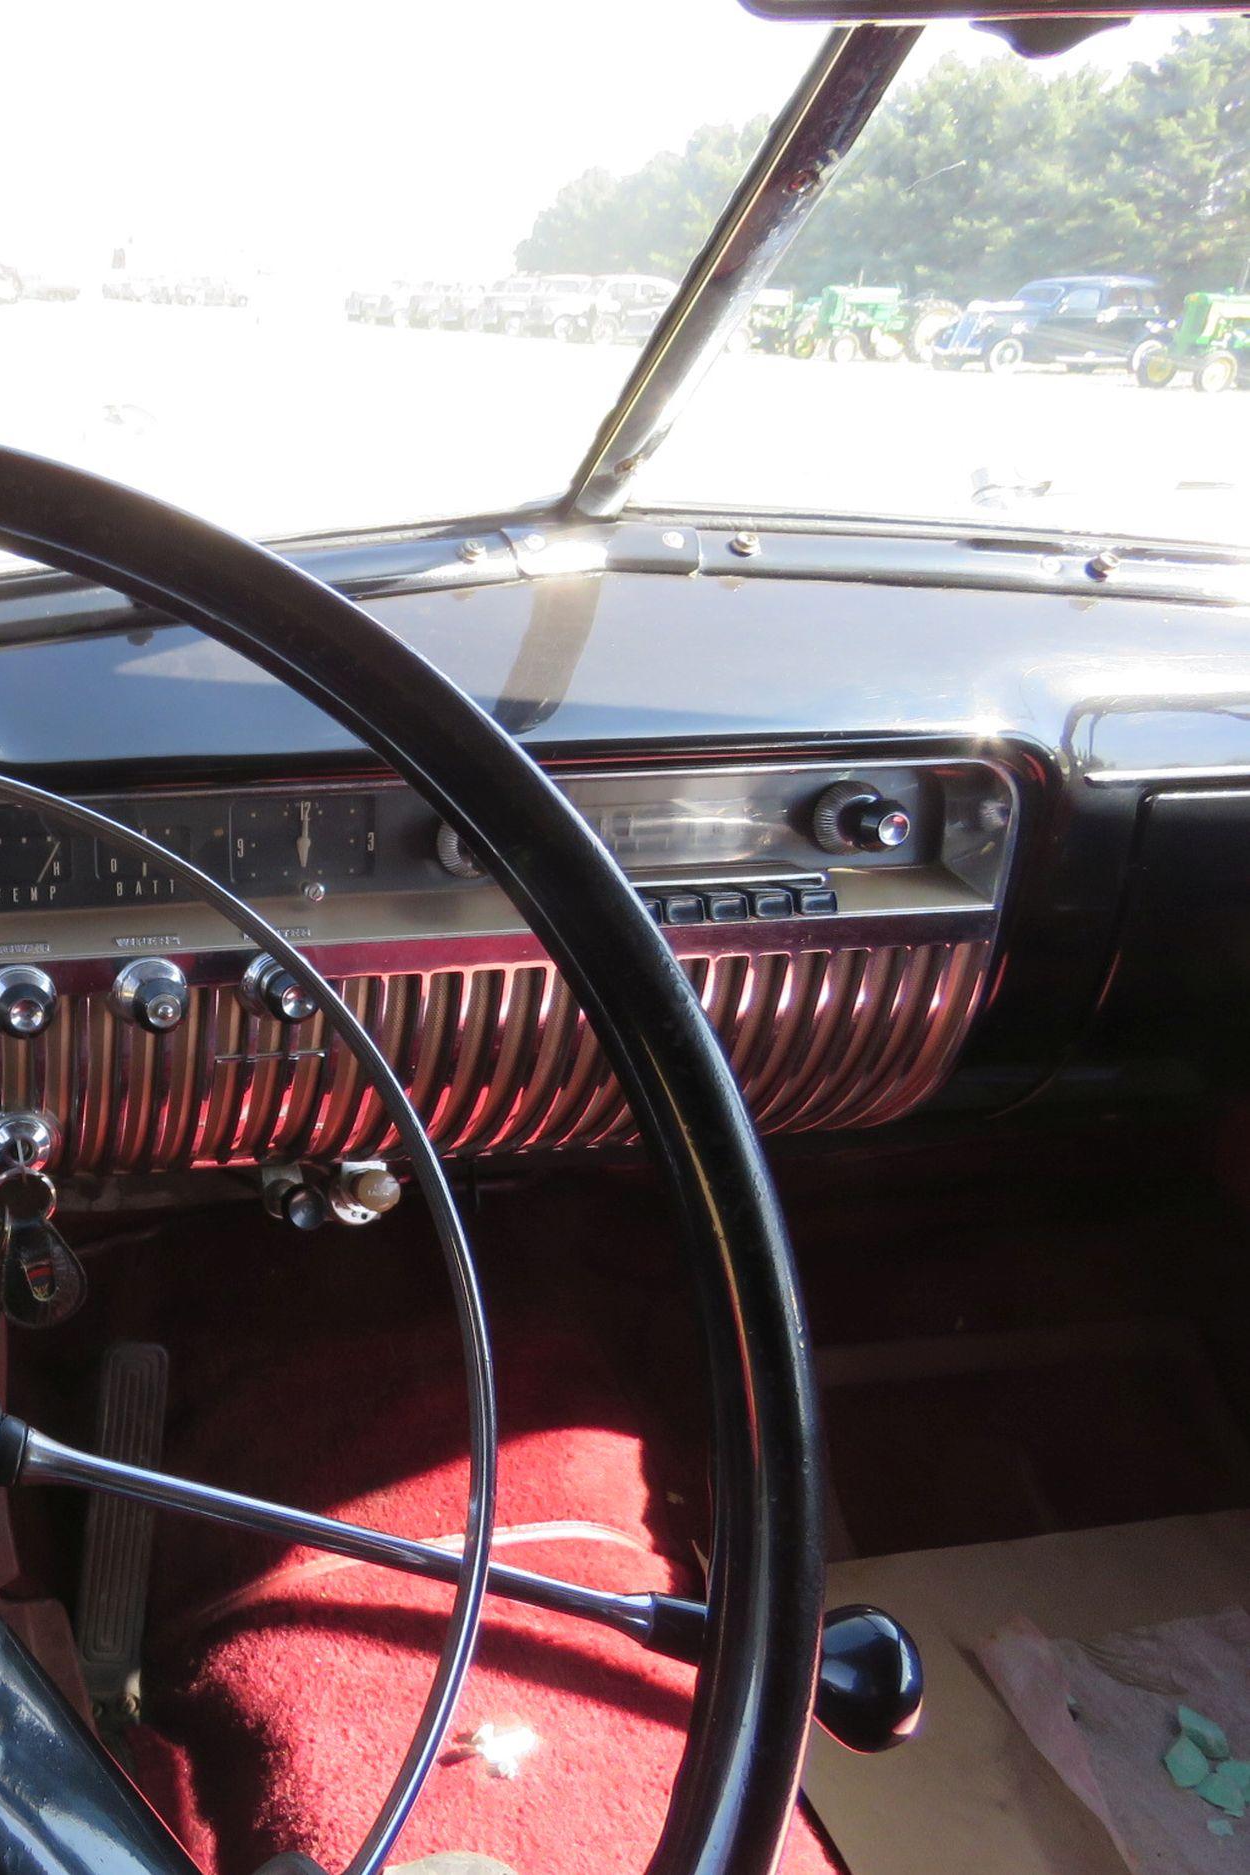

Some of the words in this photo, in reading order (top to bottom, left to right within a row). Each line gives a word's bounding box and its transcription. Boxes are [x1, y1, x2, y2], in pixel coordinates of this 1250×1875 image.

[237, 838, 244, 858] 9
[367, 832, 375, 851] 3
[116, 879, 175, 897] BATT
